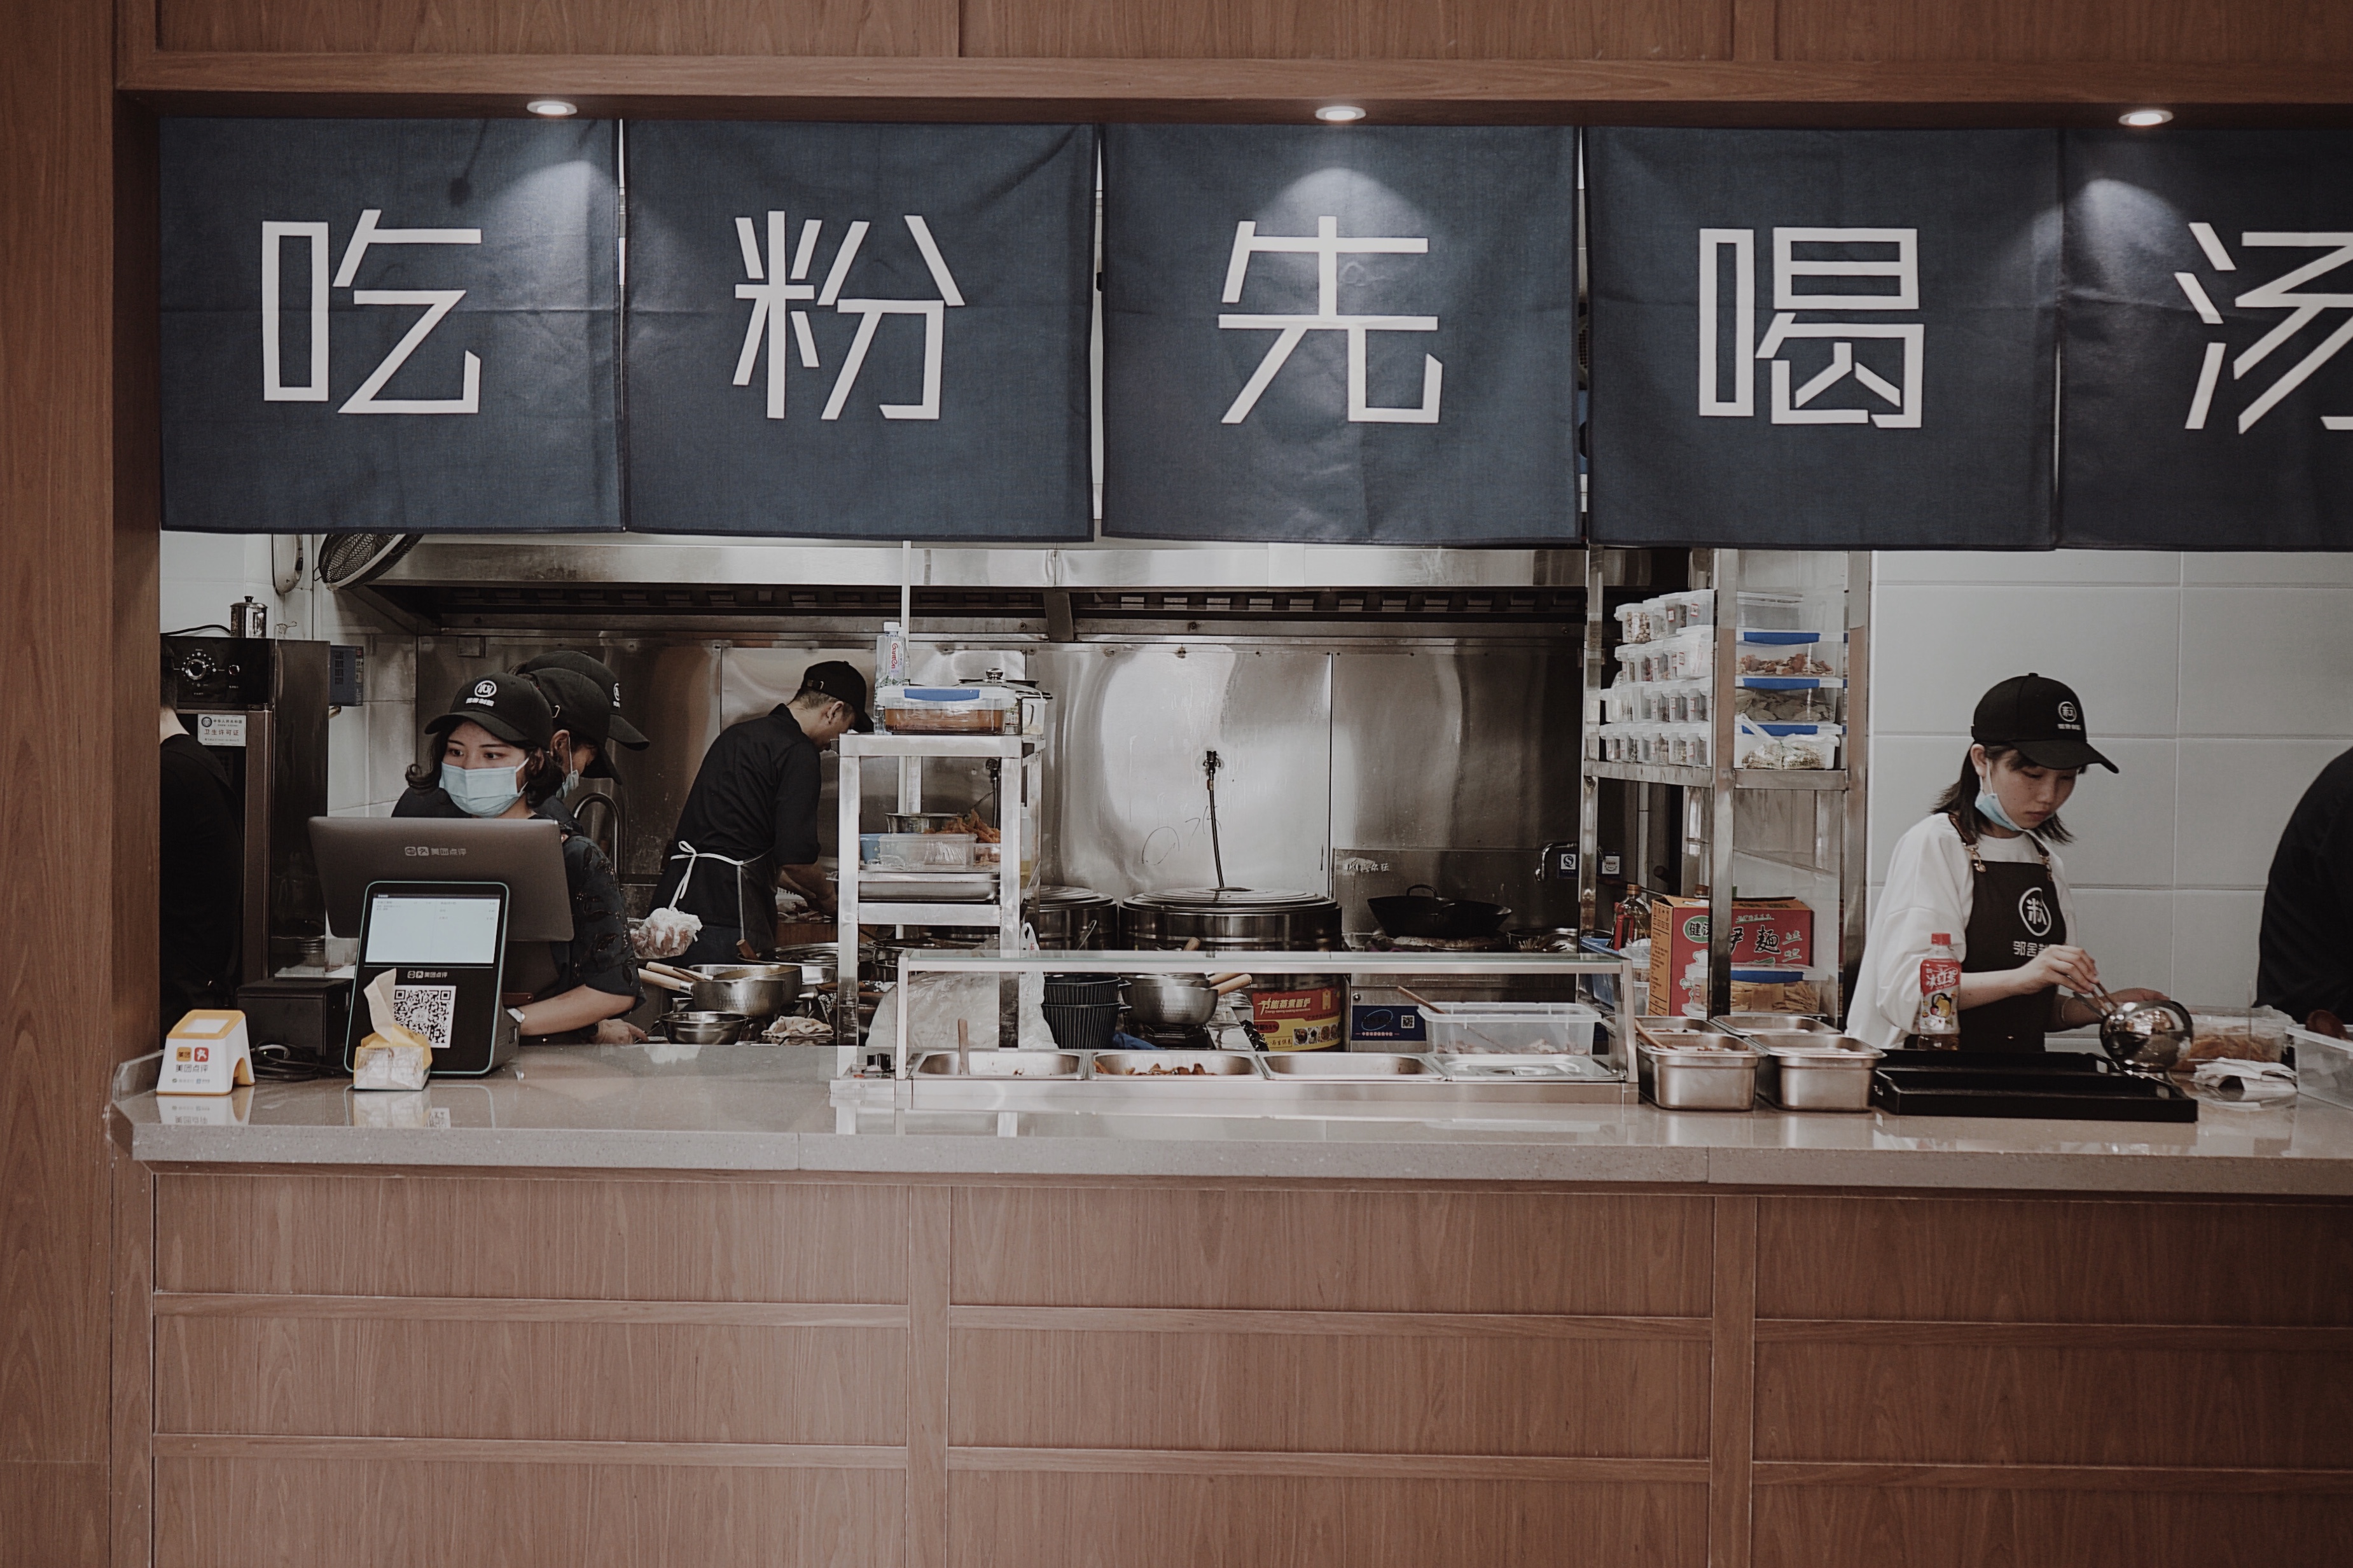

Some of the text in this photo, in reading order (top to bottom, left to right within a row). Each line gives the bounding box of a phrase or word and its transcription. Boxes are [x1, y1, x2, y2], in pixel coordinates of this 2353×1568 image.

[261, 209, 2353, 435] 吃粉先喝汤
[176, 1064, 209, 1073] 美团点评
